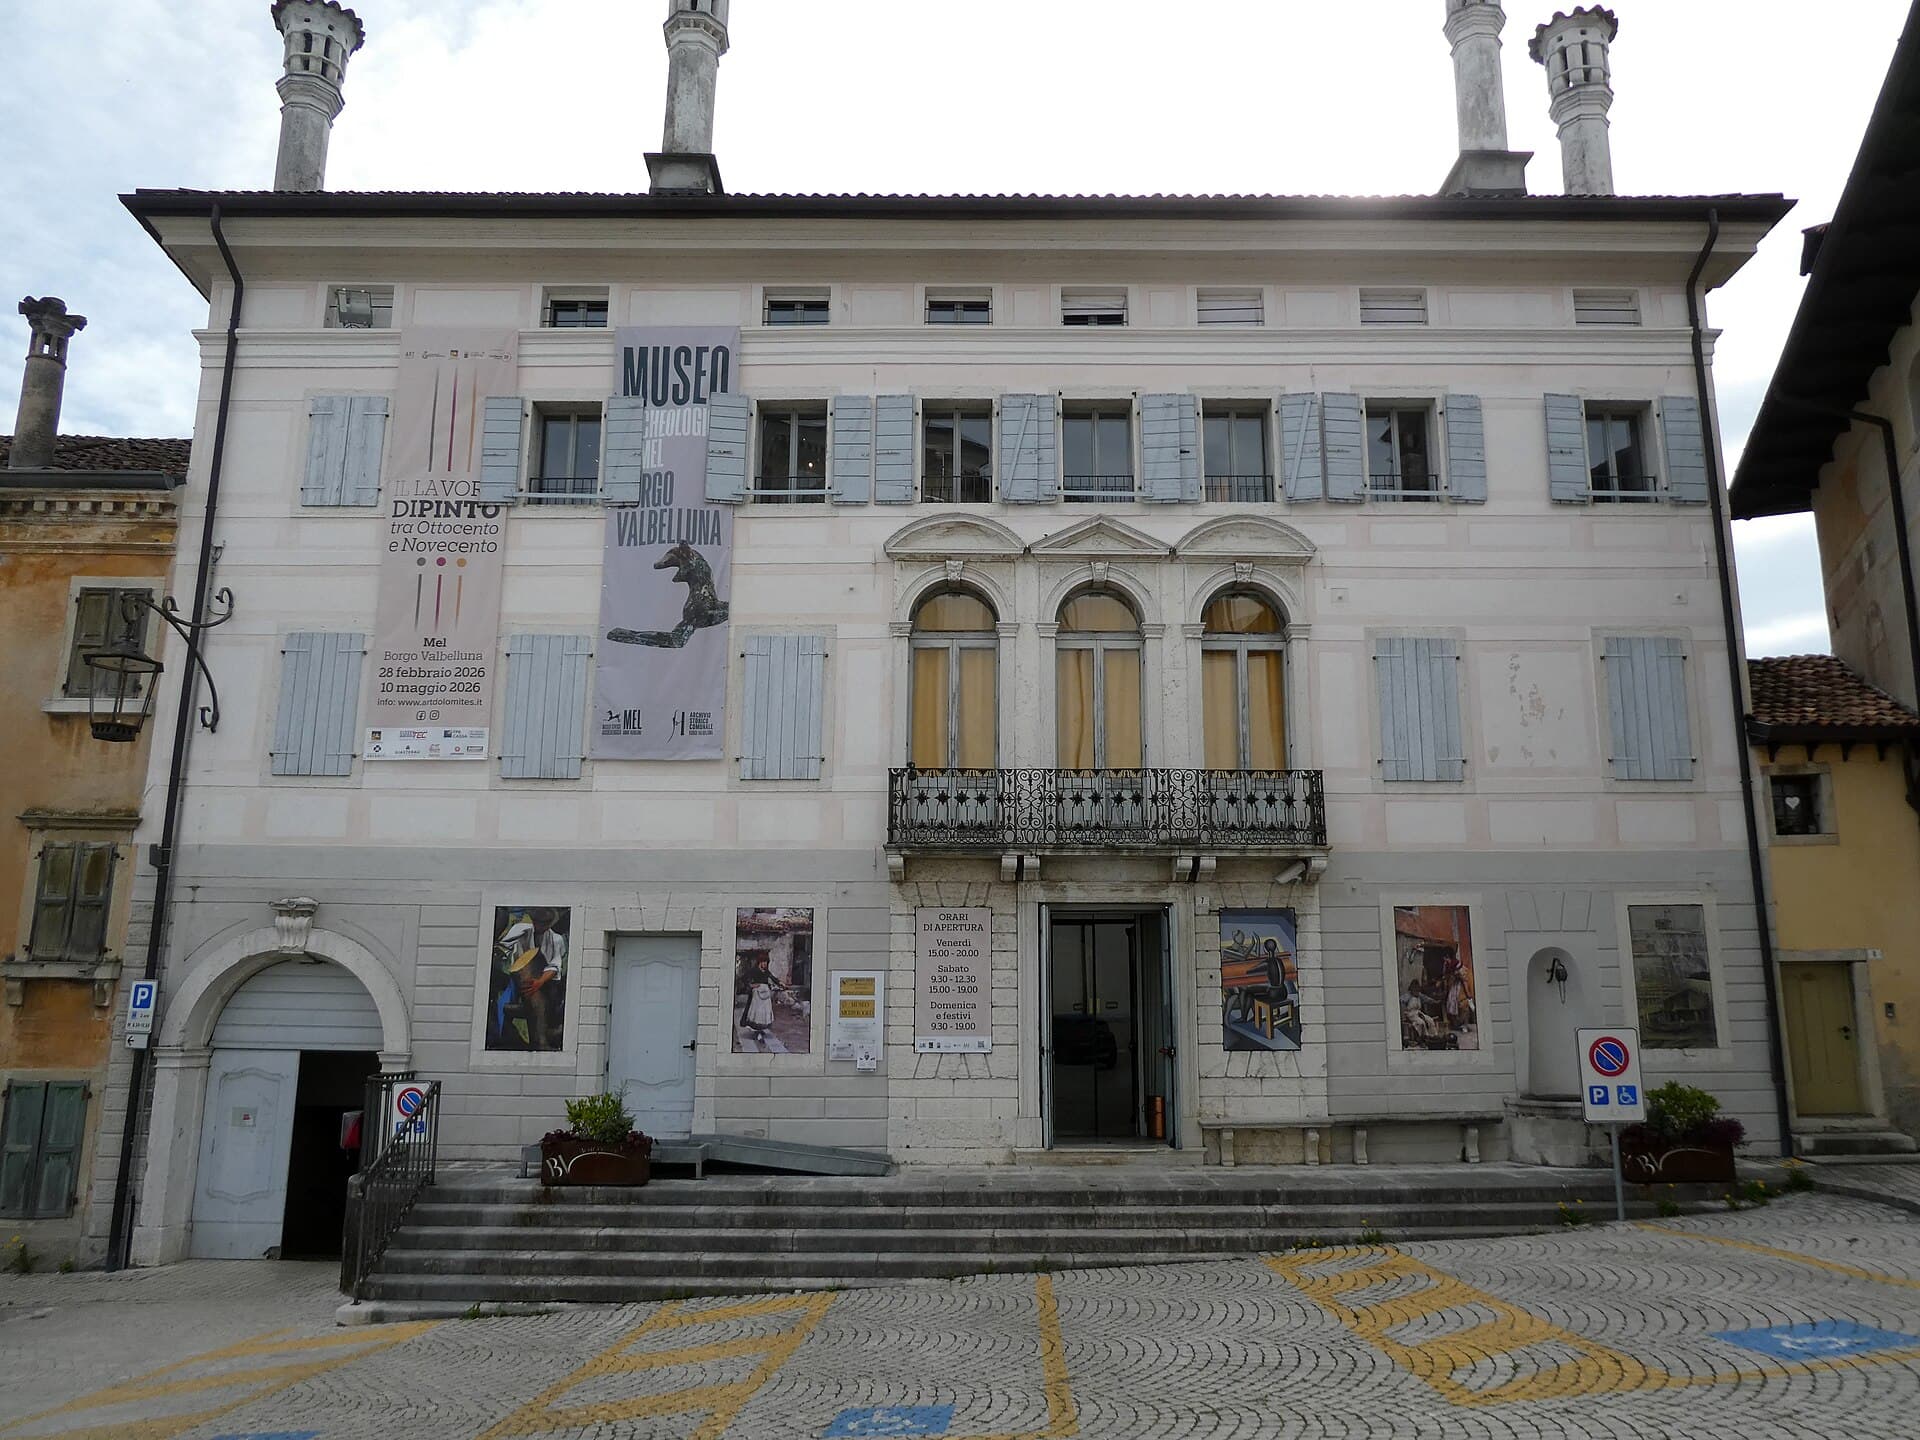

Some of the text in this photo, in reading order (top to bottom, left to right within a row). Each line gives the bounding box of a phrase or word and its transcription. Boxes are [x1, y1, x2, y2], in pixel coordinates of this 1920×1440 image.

[623, 345, 730, 407] MUSEO
[643, 407, 710, 438] CHEOLOGI
[394, 479, 481, 497] IL LAVOR
[640, 470, 675, 508] RGO
[392, 499, 500, 519] DIPINTO
[391, 520, 499, 535] tra Ottocento
[616, 508, 722, 547] VALBELLUNA
[389, 537, 498, 553] e Novecento
[423, 637, 447, 648] Mel
[384, 650, 483, 663] Borgo Valbelluna
[378, 666, 486, 678] 28 febbraio 2026
[380, 682, 481, 695] 10 maggio 2026
[397, 698, 483, 707] www.artdolomites.it
[623, 709, 642, 730] MEL
[938, 913, 969, 921] ORARI
[923, 923, 984, 932] DI APERTURA
[928, 949, 950, 957] 15.00
[956, 949, 979, 957] 20.00
[937, 964, 970, 973] Sabato
[930, 975, 948, 984] 9.30
[955, 975, 977, 983] 12.30
[929, 985, 951, 994] 15.00
[957, 985, 978, 994] 19.00
[136, 987, 150, 1007] P
[930, 1001, 977, 1010] Domenica
[943, 1011, 971, 1020] festivi
[930, 1022, 948, 1031] 9.30
[955, 1022, 976, 1031] 19.00
[1593, 1088, 1604, 1103] P
